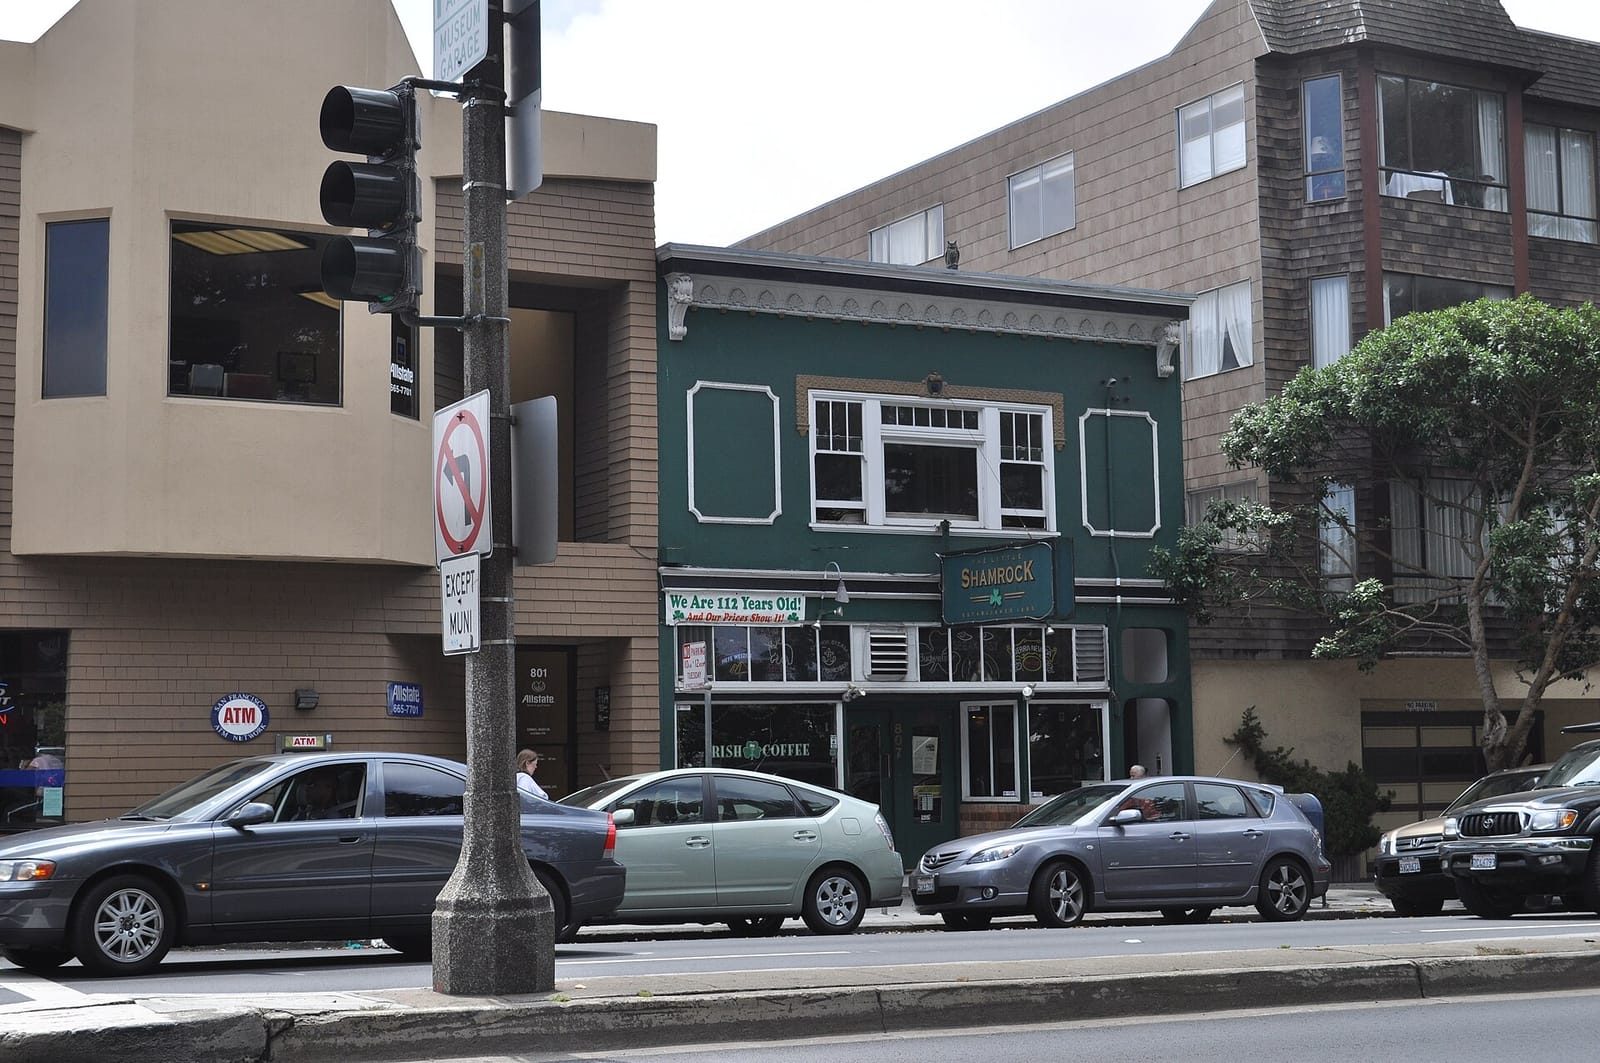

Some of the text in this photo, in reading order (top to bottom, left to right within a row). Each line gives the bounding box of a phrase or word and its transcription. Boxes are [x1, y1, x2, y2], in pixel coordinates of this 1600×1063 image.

[440, 4, 481, 55] MUSEUM
[440, 30, 480, 80] GARAGE
[961, 560, 1034, 588] SHAMROCK
[445, 569, 475, 598] EXCEPT
[670, 594, 801, 611] We Are 112 Years Old!
[449, 609, 472, 636] MUNI
[686, 612, 704, 621] And
[705, 612, 722, 622] Our
[723, 613, 748, 622] Prices
[750, 614, 773, 622] Show
[530, 668, 547, 678] 801
[214, 693, 266, 712] SAN FRANCISCO
[392, 684, 420, 703] Allstate
[521, 694, 555, 704] Allstate
[223, 707, 256, 724] ATM
[214, 723, 267, 741] ATM NETWORK
[293, 737, 316, 746] ATM
[710, 743, 810, 758] RISH COFFEE
